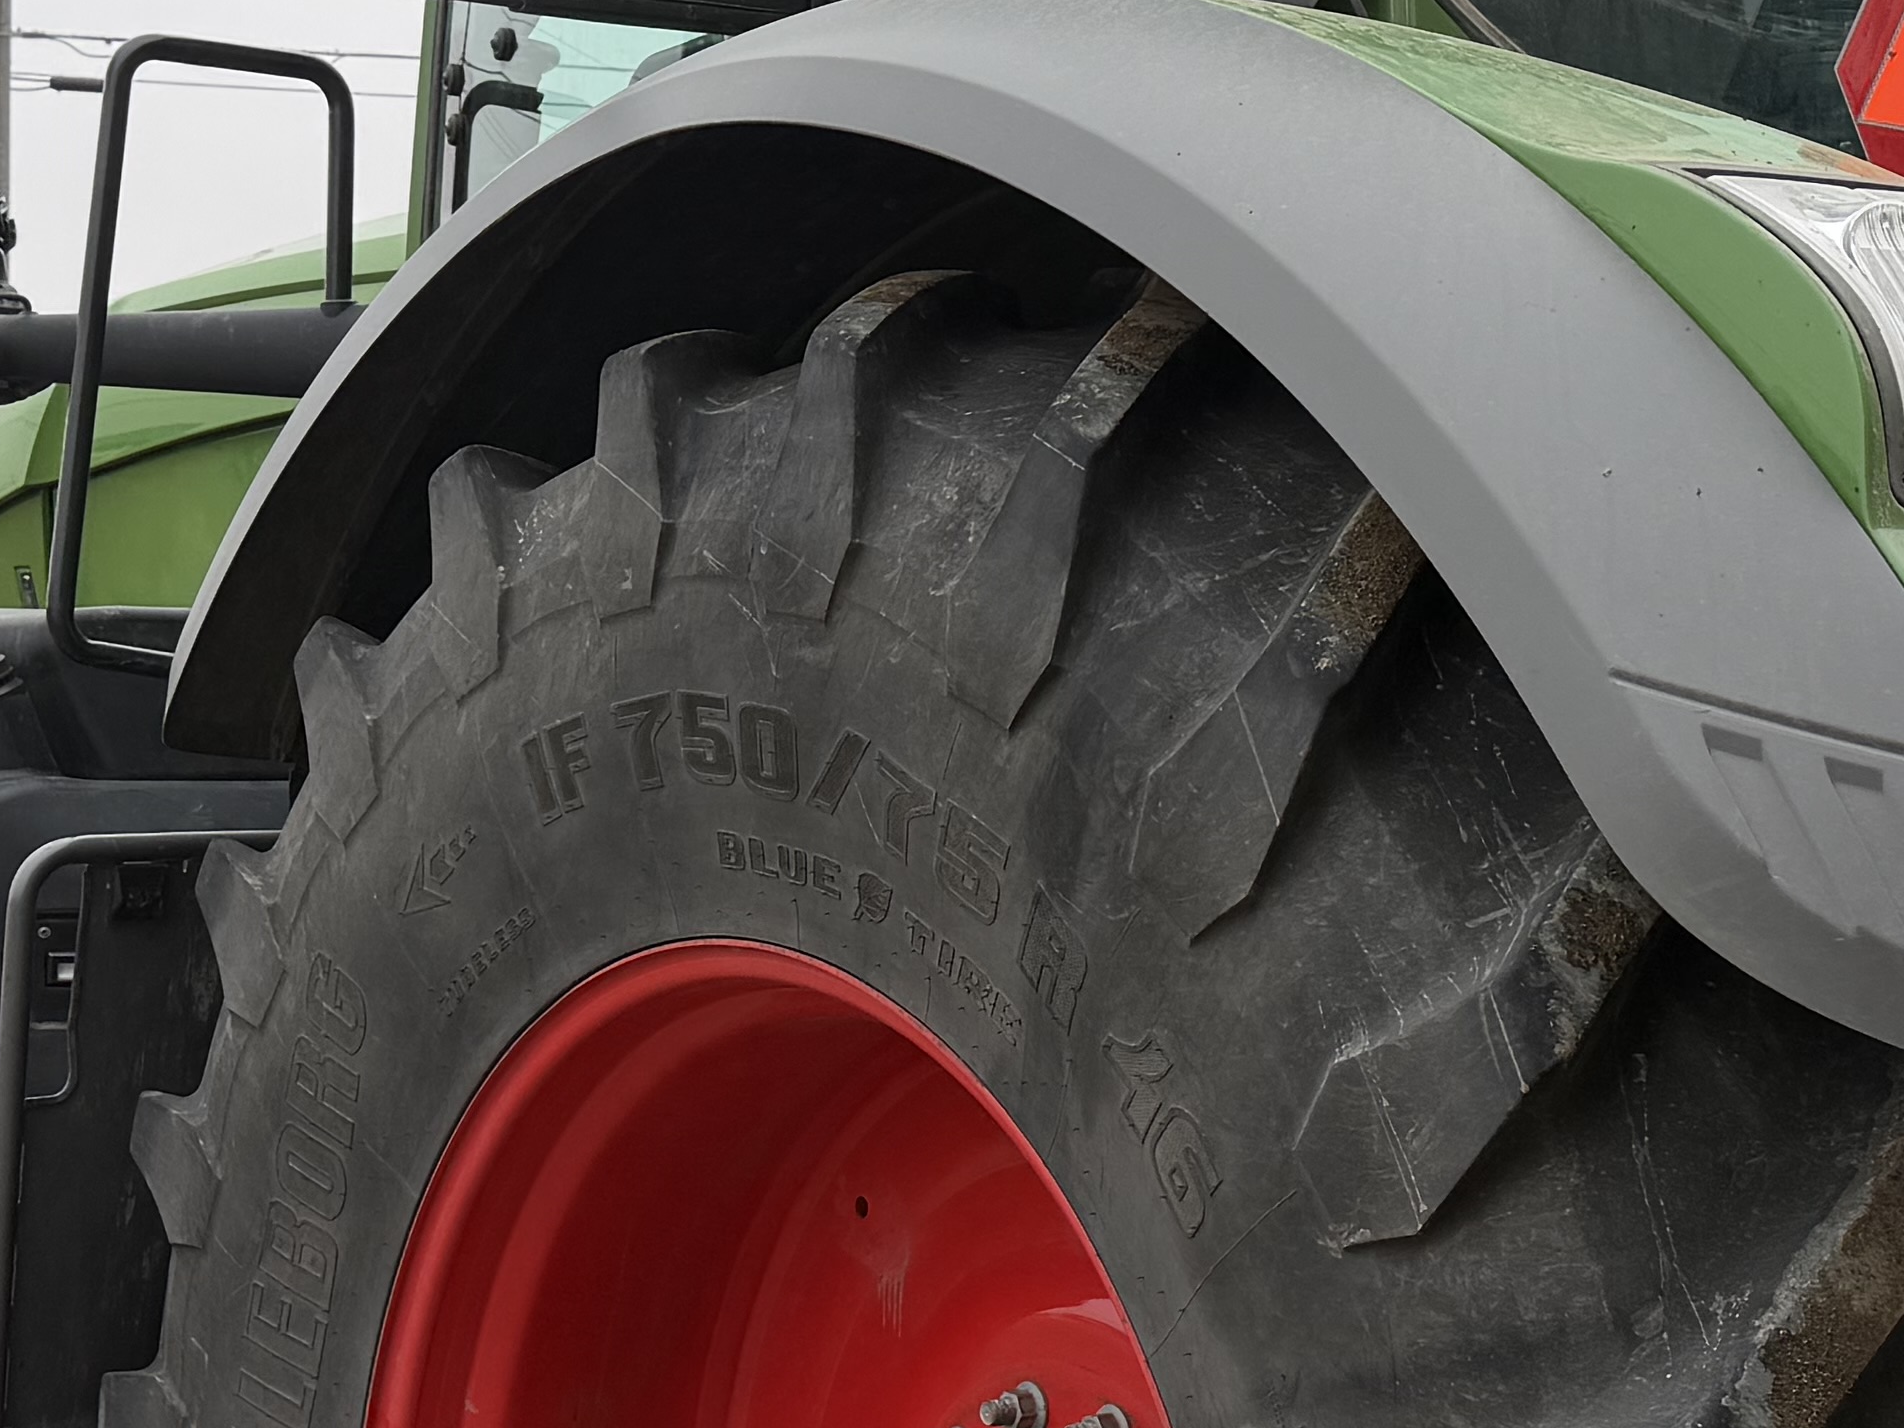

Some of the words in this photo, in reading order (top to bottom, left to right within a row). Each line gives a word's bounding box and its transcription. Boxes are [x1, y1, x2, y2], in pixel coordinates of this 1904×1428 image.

[436, 905, 538, 1017] TUBELESS
[519, 711, 592, 827] IF
[610, 688, 1011, 926] 750/75
[1017, 879, 1089, 1037] R
[1101, 1030, 1223, 1240] 46
[716, 828, 842, 901] BLUE
[902, 905, 1025, 1049] TIRE
